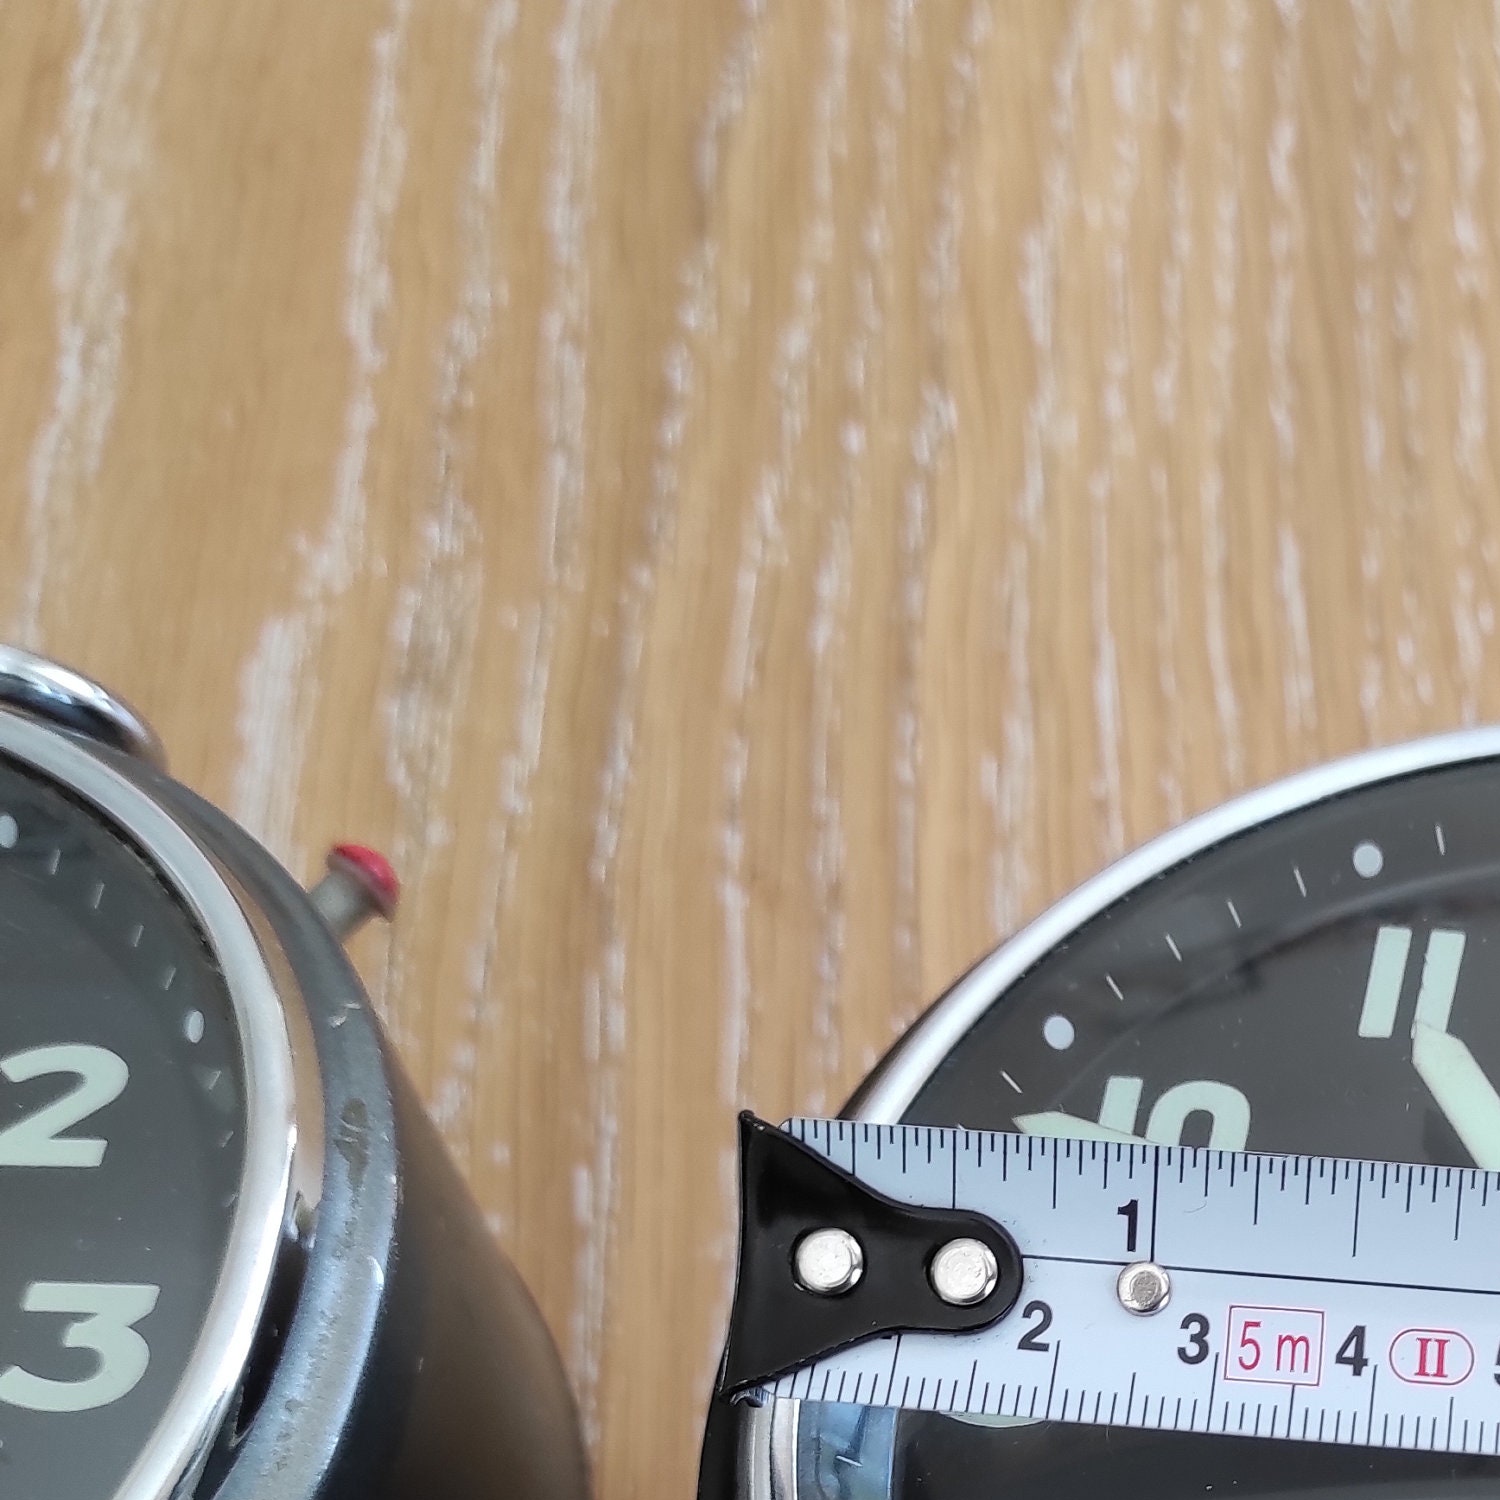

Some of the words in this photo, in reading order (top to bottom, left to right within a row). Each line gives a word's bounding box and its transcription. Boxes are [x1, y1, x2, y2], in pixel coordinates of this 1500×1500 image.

[0, 1043, 129, 1167] 2
[1117, 1199, 1139, 1252] 1
[0, 1281, 161, 1412] 3
[1018, 1300, 1053, 1352] 2
[1177, 1313, 1211, 1365] 3
[1335, 1325, 1369, 1377] 4
